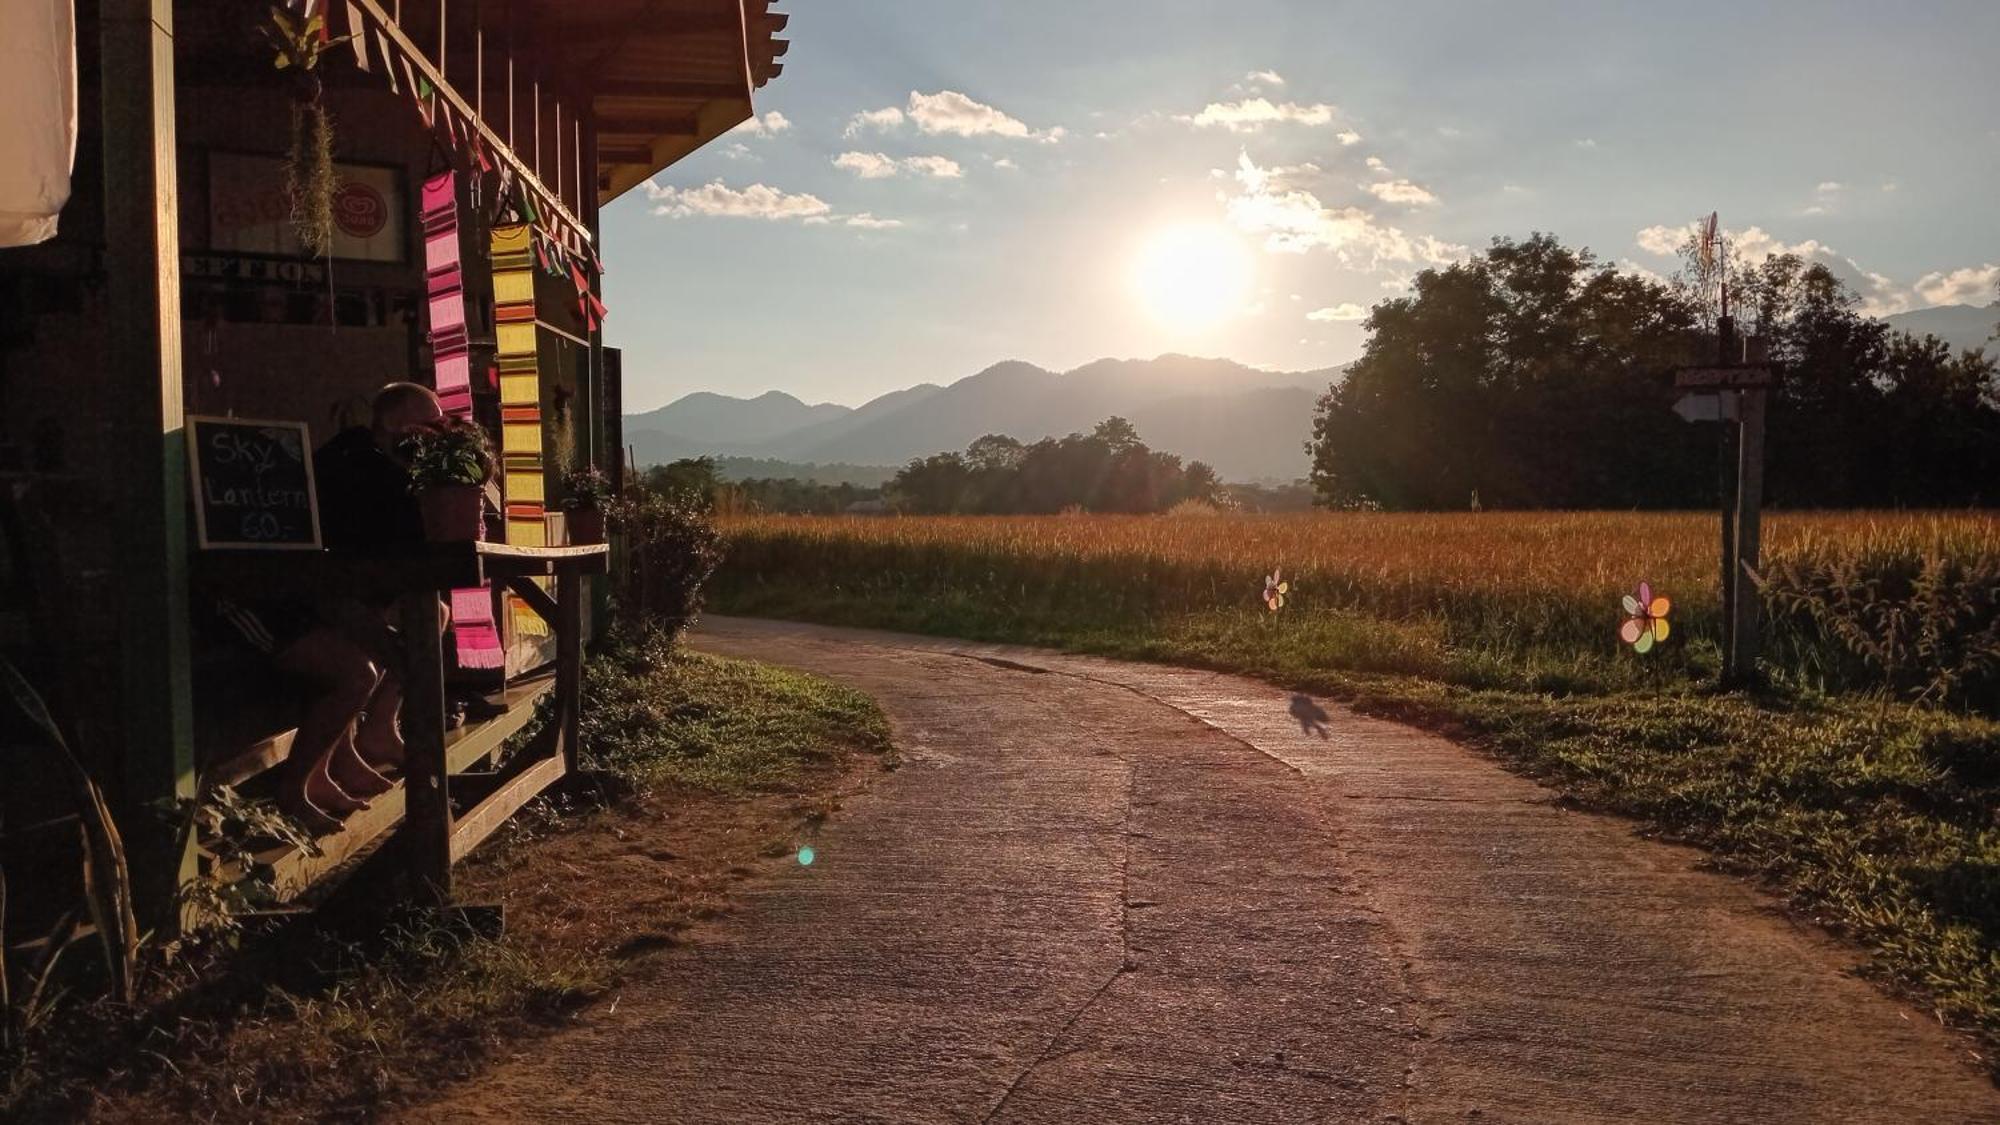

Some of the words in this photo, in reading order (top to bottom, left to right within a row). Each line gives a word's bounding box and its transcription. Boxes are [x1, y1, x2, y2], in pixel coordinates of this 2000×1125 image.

[184, 255, 324, 282] EPTION
[211, 432, 277, 474] Sky
[204, 476, 307, 508] Lantern
